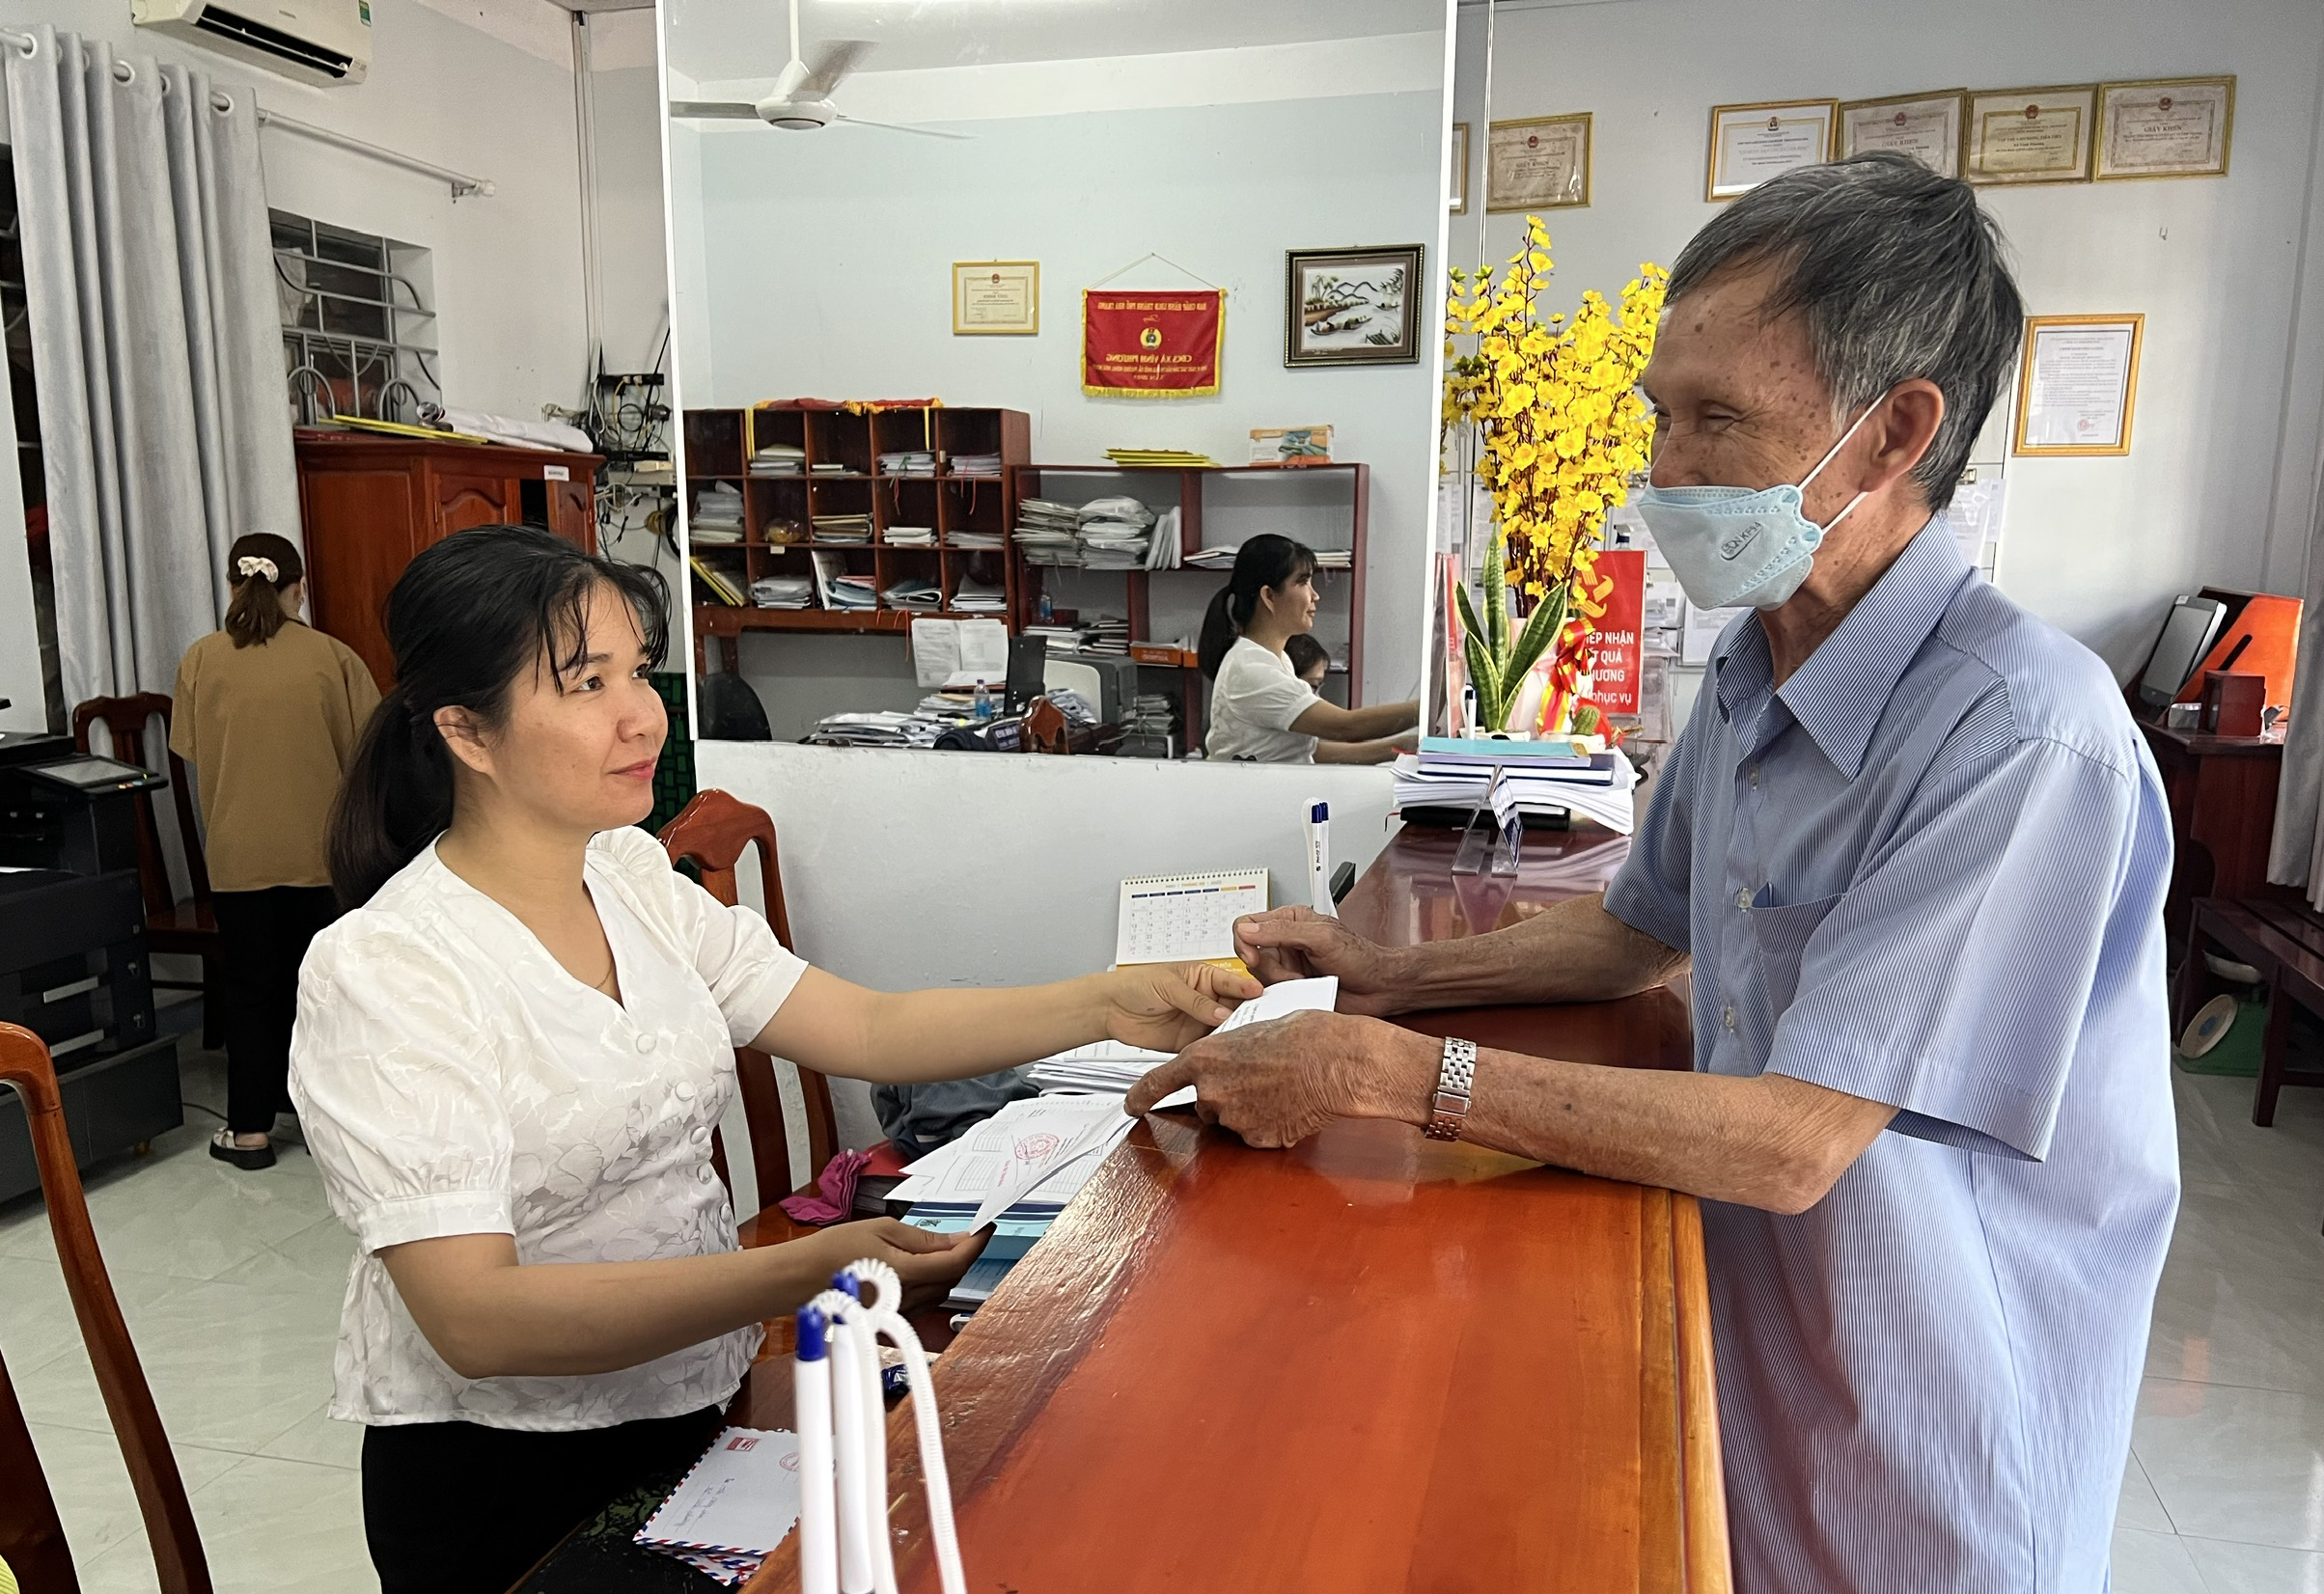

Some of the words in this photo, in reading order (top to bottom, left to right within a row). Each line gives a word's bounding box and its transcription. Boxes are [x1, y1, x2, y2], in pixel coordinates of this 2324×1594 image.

[1605, 630, 1634, 646] NHẬN
[1600, 647, 1623, 666] QUẢ
[1619, 693, 1632, 706] vụ
